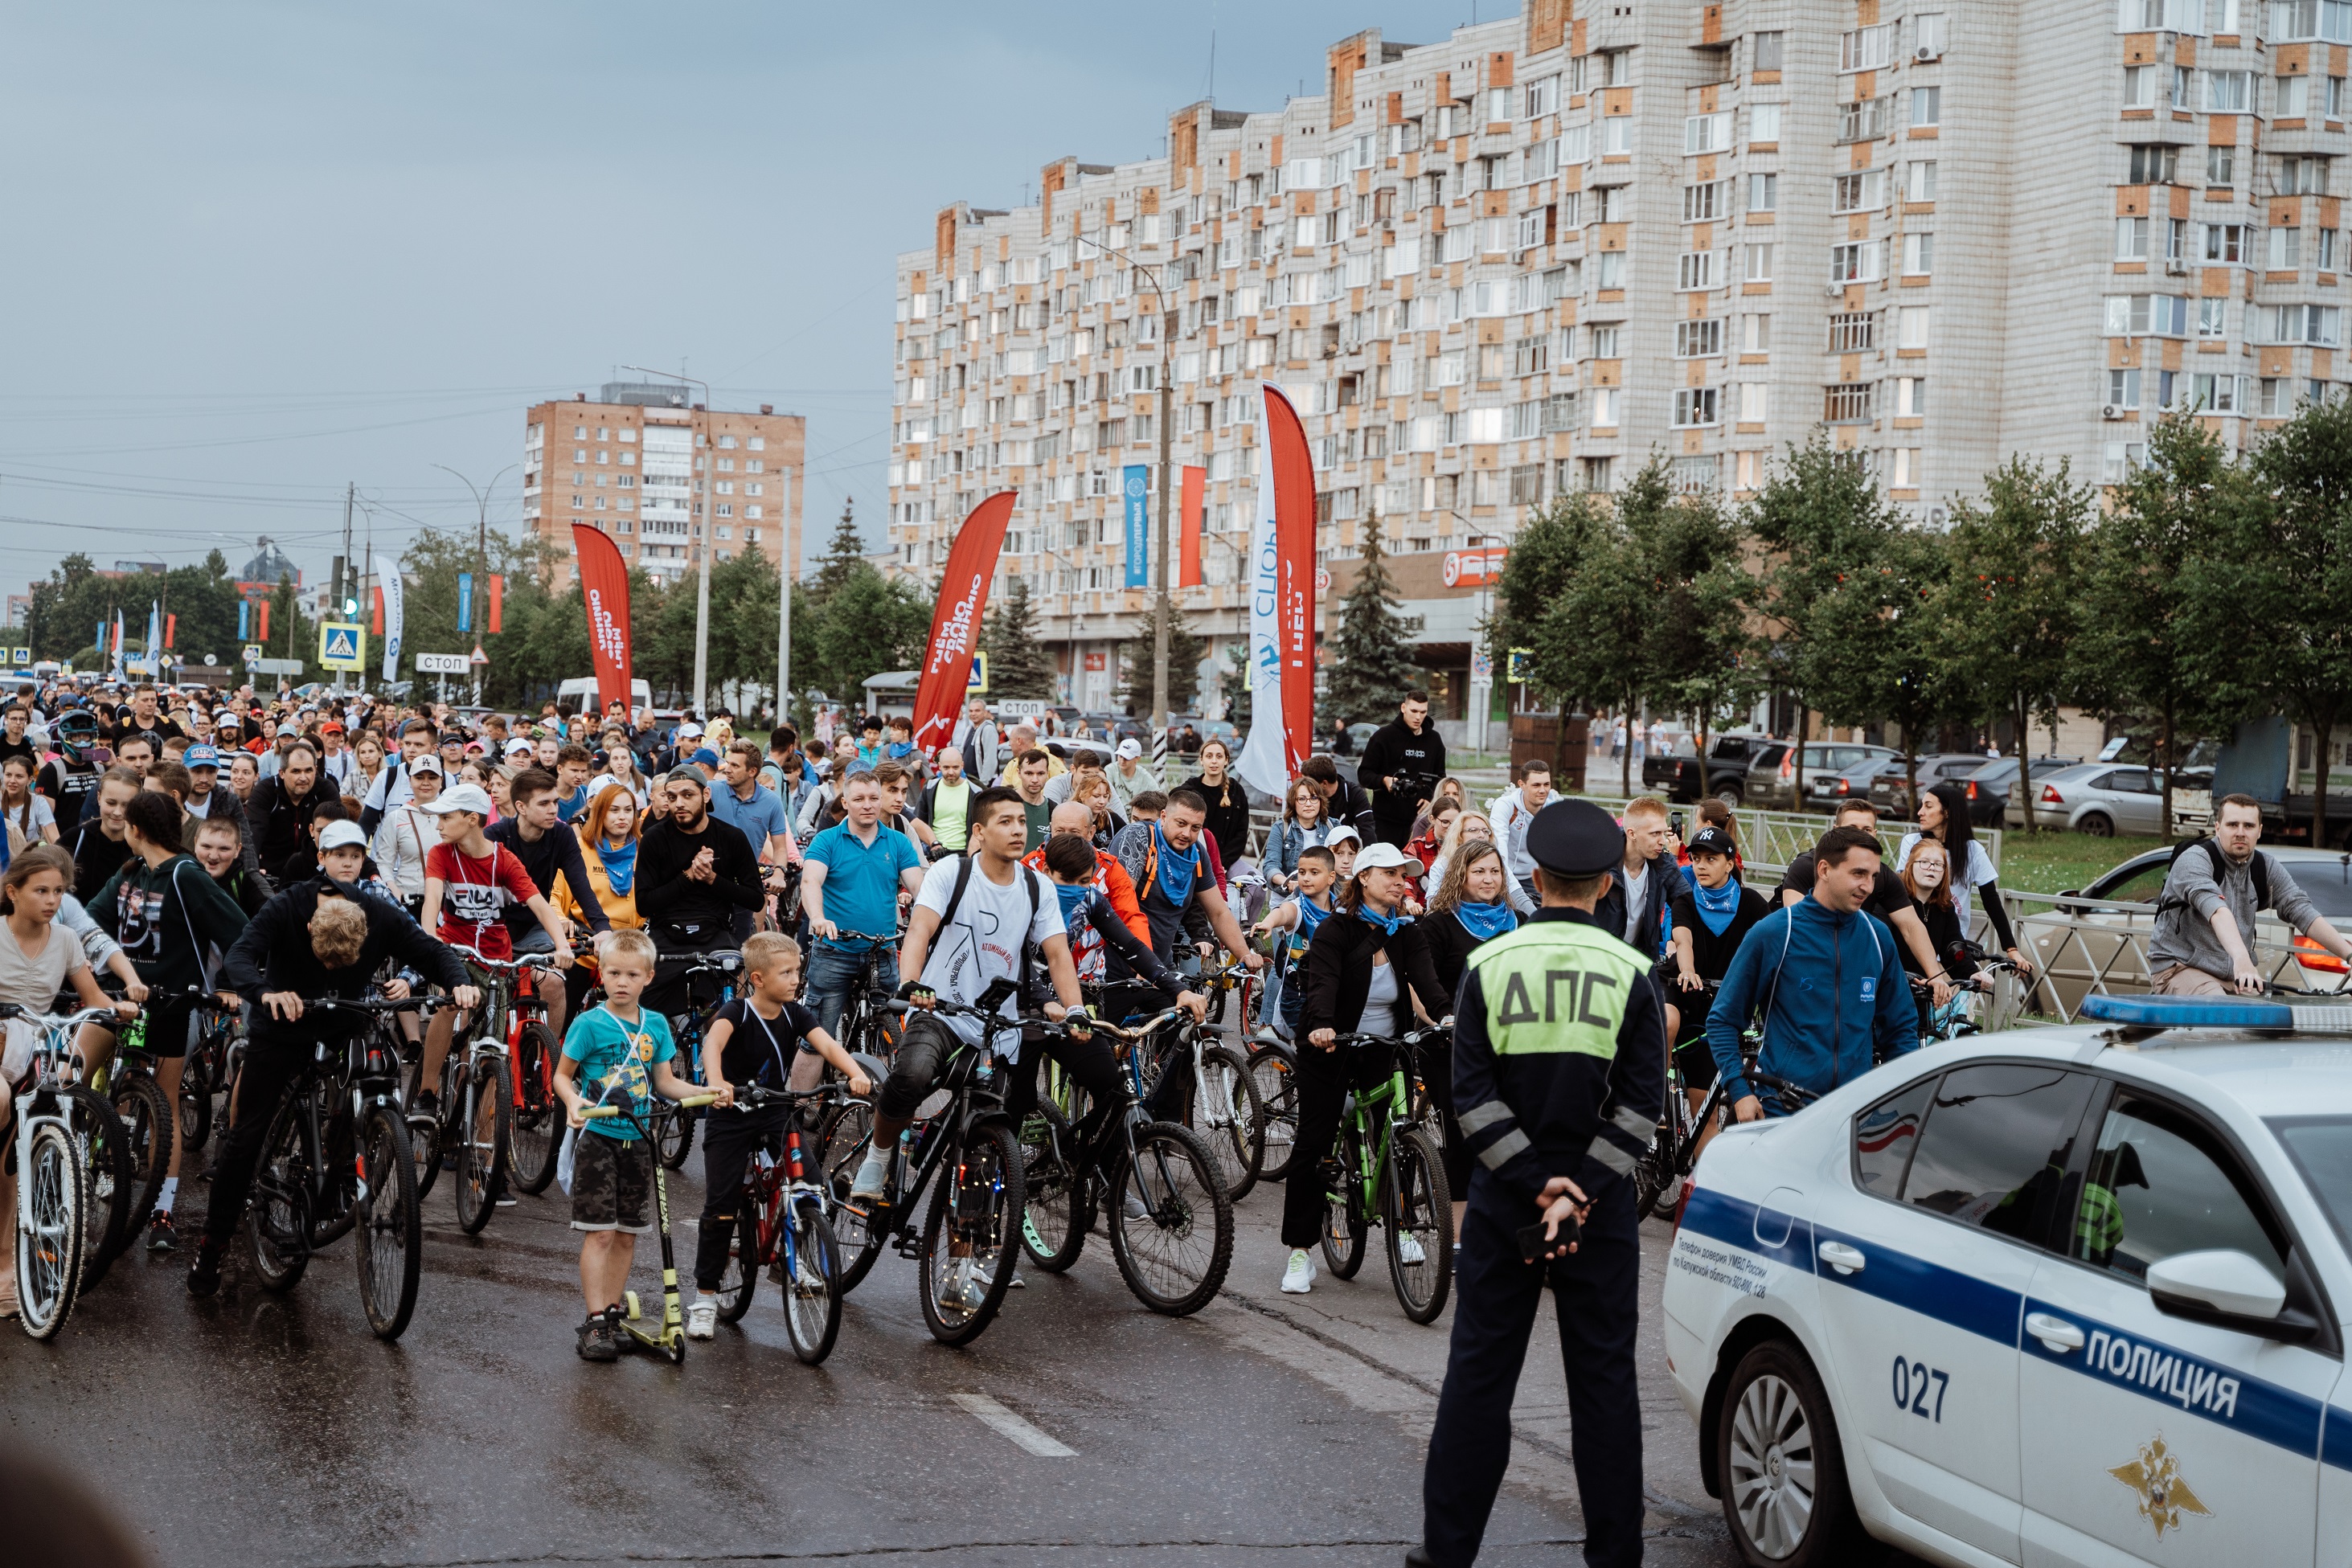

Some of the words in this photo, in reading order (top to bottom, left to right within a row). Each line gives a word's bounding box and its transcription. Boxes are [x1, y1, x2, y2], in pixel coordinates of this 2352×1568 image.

[1133, 502, 1143, 575] #ГОРОДПЕРВЫХ
[955, 574, 981, 654] ЛИНИЮ
[424, 657, 461, 669] СТОП
[1005, 702, 1039, 714] СТОП
[455, 889, 495, 906] FILA
[981, 944, 1007, 957] АТОМНЫЙ
[1498, 970, 1617, 1030] ДПС
[1673, 1257, 1680, 1267] по
[1681, 1257, 1708, 1279] Калужской
[1709, 1267, 1733, 1285] области
[1754, 1283, 1767, 1299] 128
[1678, 1238, 1702, 1255] Телефон
[1701, 1248, 1727, 1265] доверия
[1728, 1254, 1745, 1273] УМВД
[1745, 1260, 1768, 1279] России
[1892, 1355, 1950, 1425] 027
[2086, 1330, 2241, 1419] ПОЛИЦИЯ
